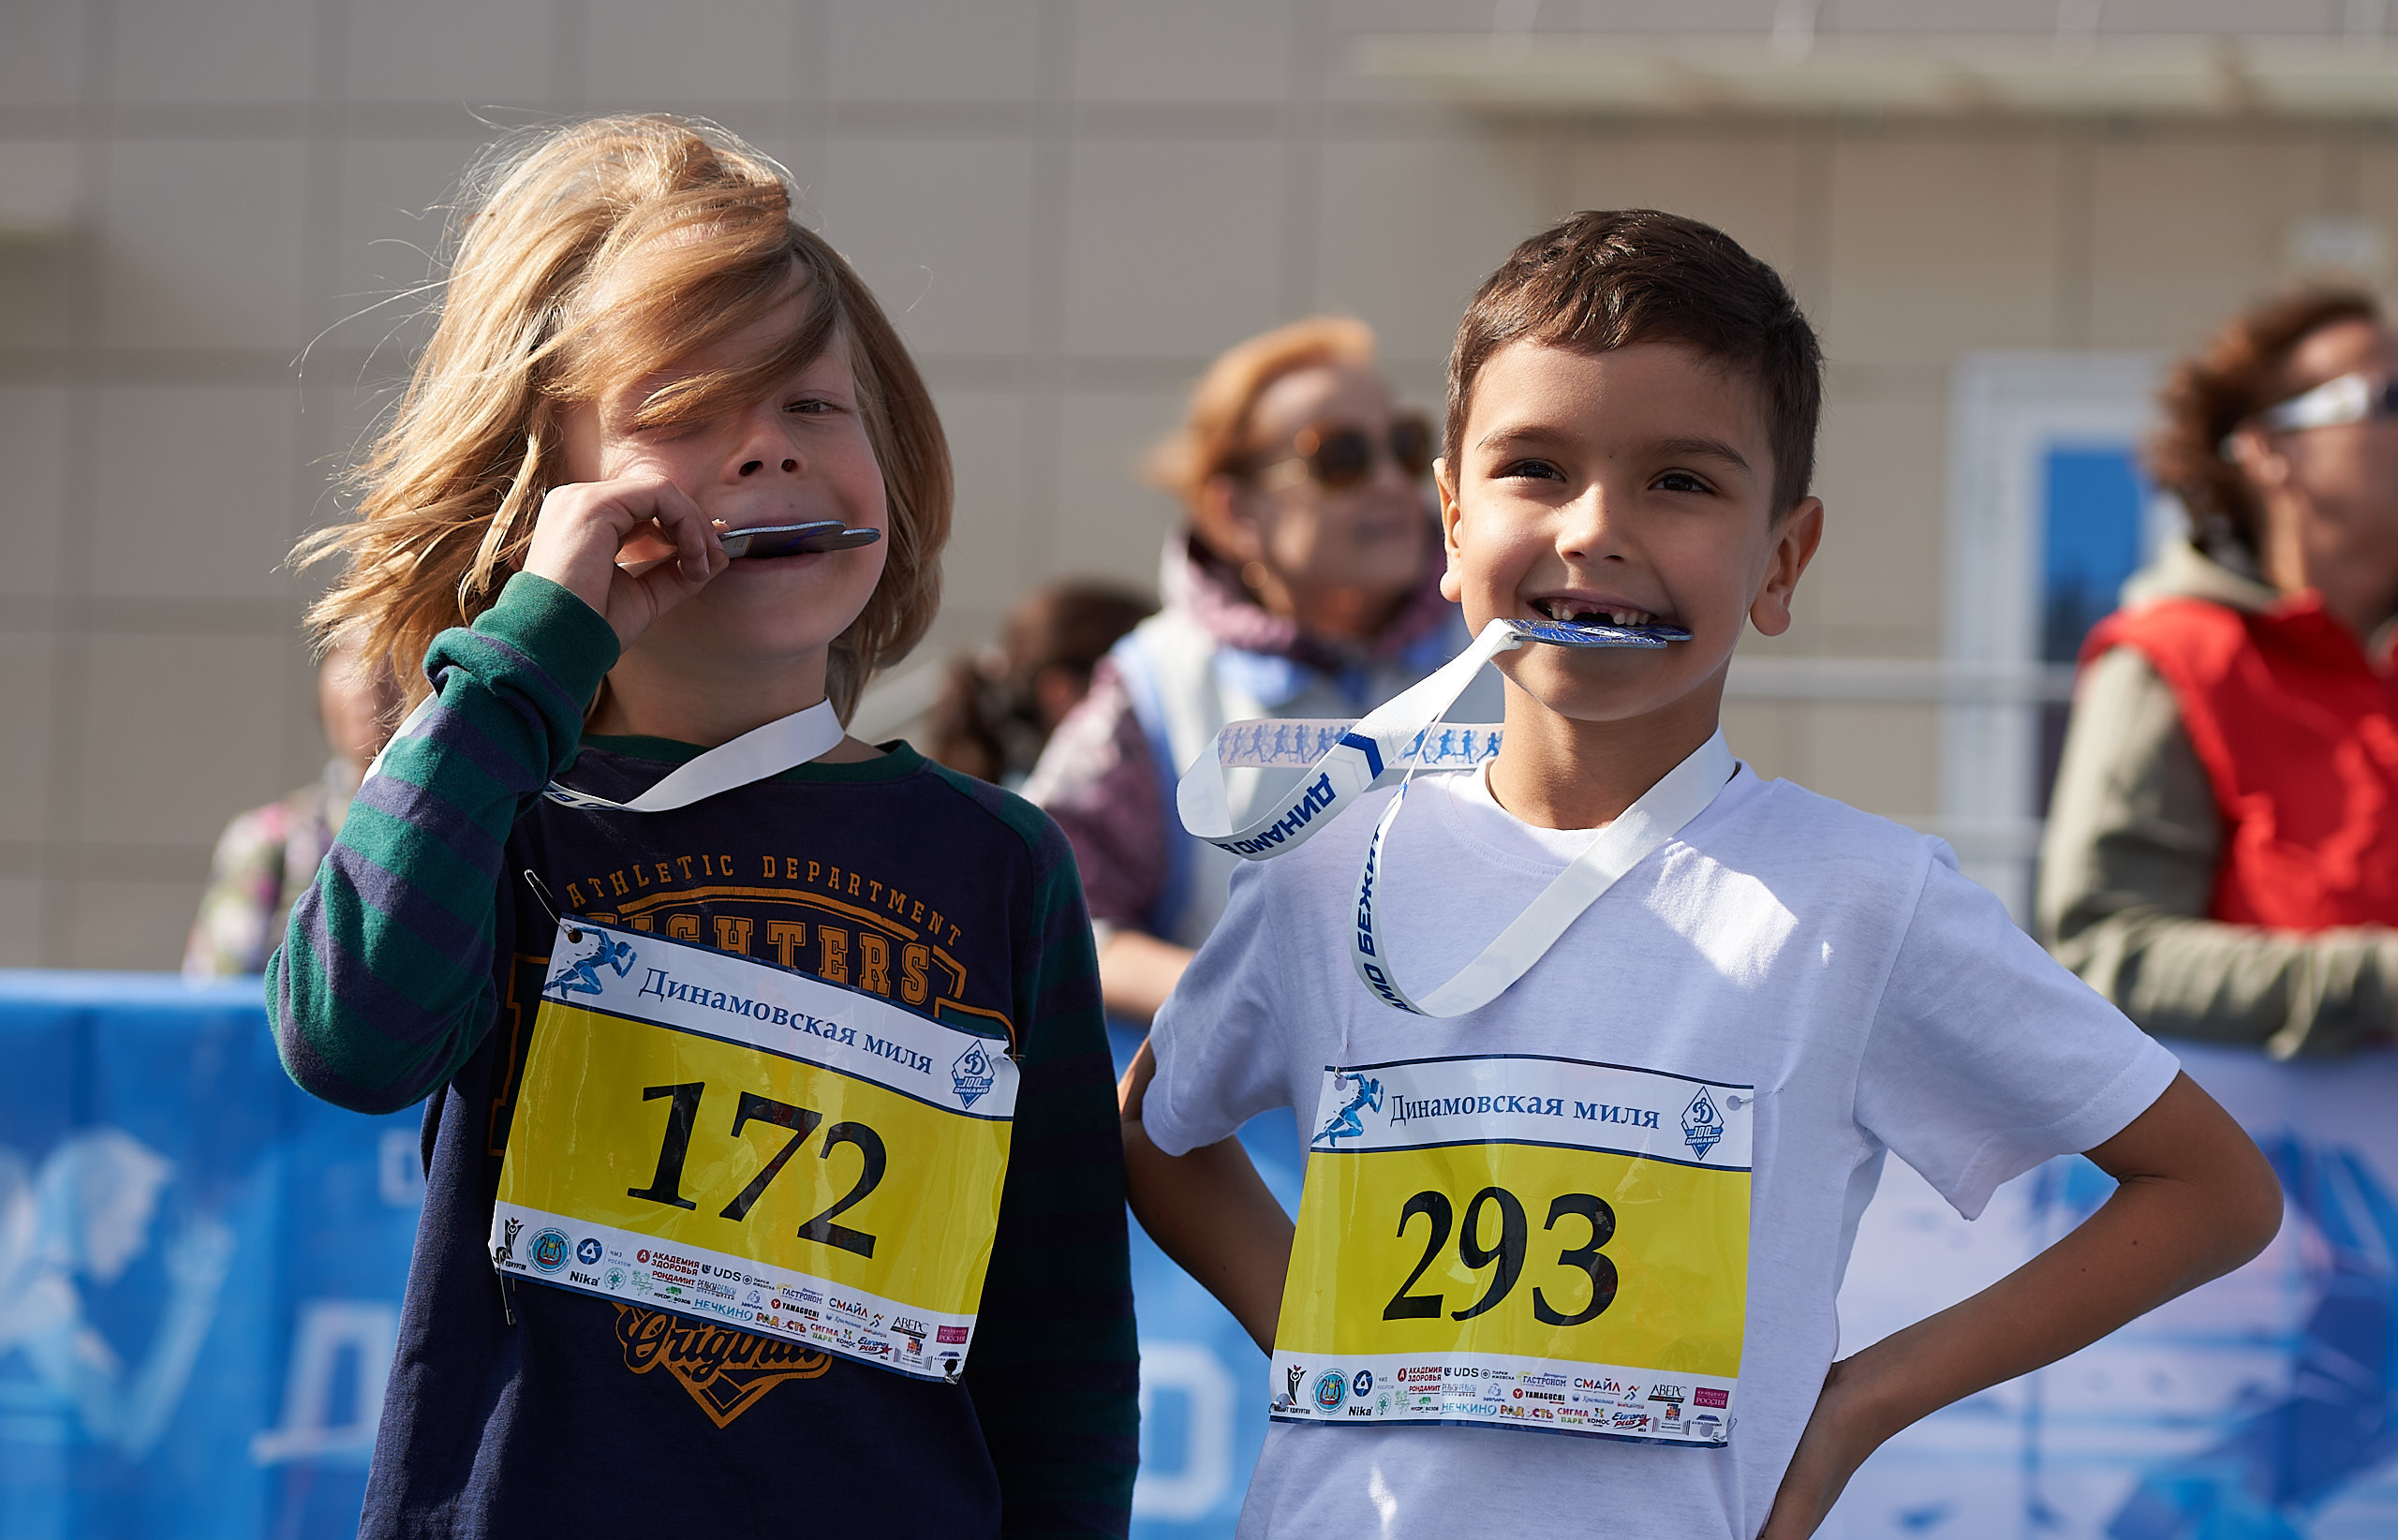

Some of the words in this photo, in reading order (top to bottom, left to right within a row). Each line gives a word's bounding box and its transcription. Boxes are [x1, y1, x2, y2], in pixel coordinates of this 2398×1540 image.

[1234, 772, 1336, 854] ДИНАМО
[567, 855, 733, 907] ATHLETIC
[762, 855, 962, 945] DEPARTMENT
[585, 912, 929, 1005] GHTERS
[639, 968, 858, 1047] Динамовская
[865, 1032, 933, 1074] миля
[961, 1076, 984, 1087] 100
[1389, 1094, 1564, 1128] Динамовская
[1573, 1101, 1660, 1130] миля
[1694, 1126, 1712, 1137] 100
[1686, 1136, 1720, 1145] ДИНАМО
[628, 1082, 887, 1259] 172
[611, 1250, 623, 1258] ЧМЗ
[653, 1251, 700, 1268] АКАДЕМИЯ
[1383, 1186, 1619, 1326] 293
[651, 1260, 698, 1276] ЗДОРОВЬЯ
[714, 1266, 742, 1281] UDS
[570, 1270, 600, 1287] Nika
[652, 1271, 696, 1286] РОНДАМИТ
[753, 1282, 776, 1291] ИЖЕВСКА
[782, 1288, 822, 1304] ГАСТРОНОМ
[694, 1298, 753, 1322] НЕЧКИНО
[782, 1303, 820, 1318] YAMAGUCHI
[829, 1297, 868, 1318] СМАЙЛ
[810, 1323, 838, 1337] СИГМА
[892, 1317, 929, 1334] АВЕРС
[812, 1333, 834, 1343] ПАРК
[836, 1338, 856, 1348] КОМОС
[1454, 1368, 1479, 1377] UDS
[1523, 1375, 1566, 1387] ГАСТРОНОМ
[1574, 1378, 1621, 1392] СМАЙЛ
[1525, 1391, 1565, 1401] YAMAGUCHI
[1650, 1385, 1687, 1397] АВЕРС
[1442, 1402, 1497, 1416] НЕЧКИНО
[1695, 1398, 1725, 1406] РОССИЯ
[1348, 1406, 1371, 1416] Nika
[1557, 1408, 1589, 1417] СИГМА
